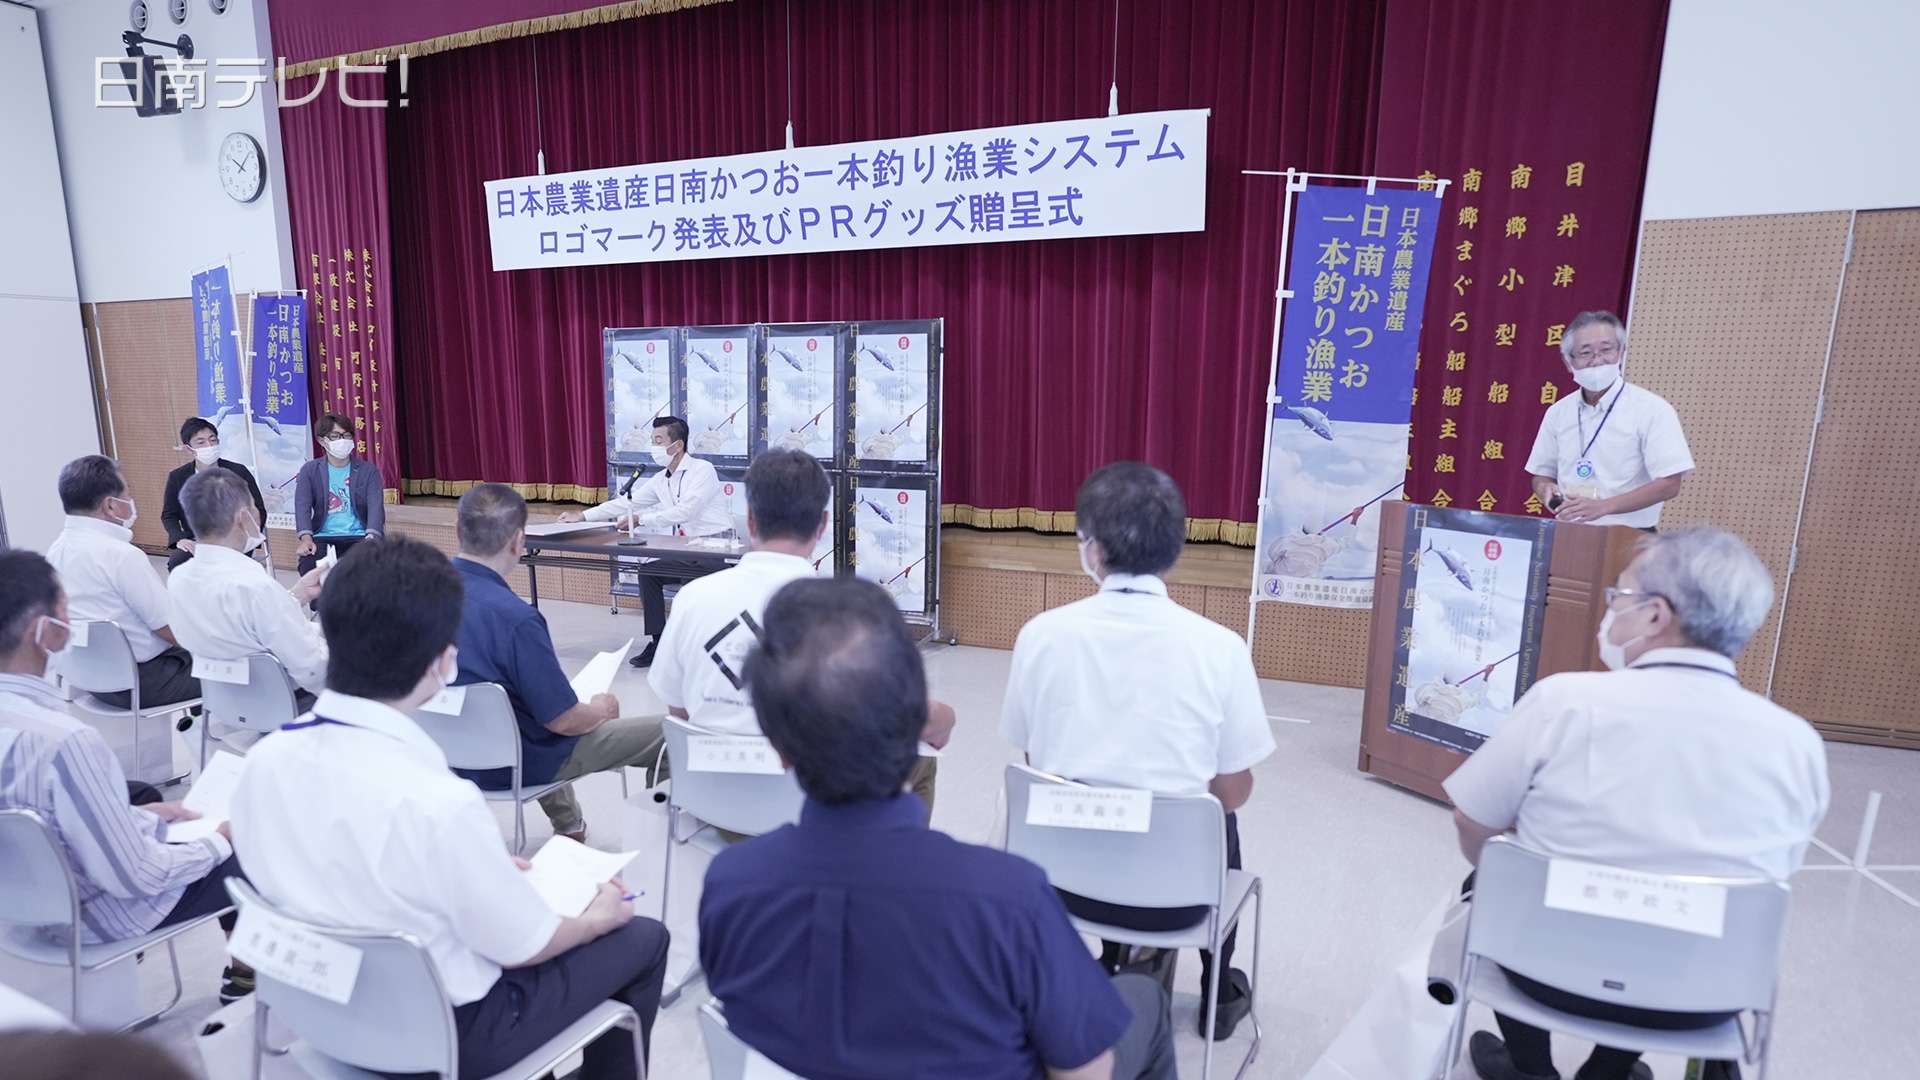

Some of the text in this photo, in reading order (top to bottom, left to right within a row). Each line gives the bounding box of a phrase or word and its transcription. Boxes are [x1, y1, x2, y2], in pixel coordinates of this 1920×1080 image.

[497, 123, 1186, 218] 日本農業遺産日南かつお一本釣り漁業システム
[540, 186, 1084, 254] ロゴマーク発表及びPRグッズ贈呈式
[265, 311, 280, 414] 一本釣り漁業
[278, 303, 294, 407] 日南かつお
[1301, 211, 1355, 403] 一本釣り漁業
[1339, 203, 1390, 389] 日南かつお
[1384, 207, 1420, 332] 日本農業遺産
[1431, 167, 1484, 508] 南郷まぐろ船船主組合
[1477, 163, 1533, 511] 南郷小型船組合
[1523, 161, 1586, 515] 目井津区自会
[1393, 509, 1428, 727] 日本農業遺産
